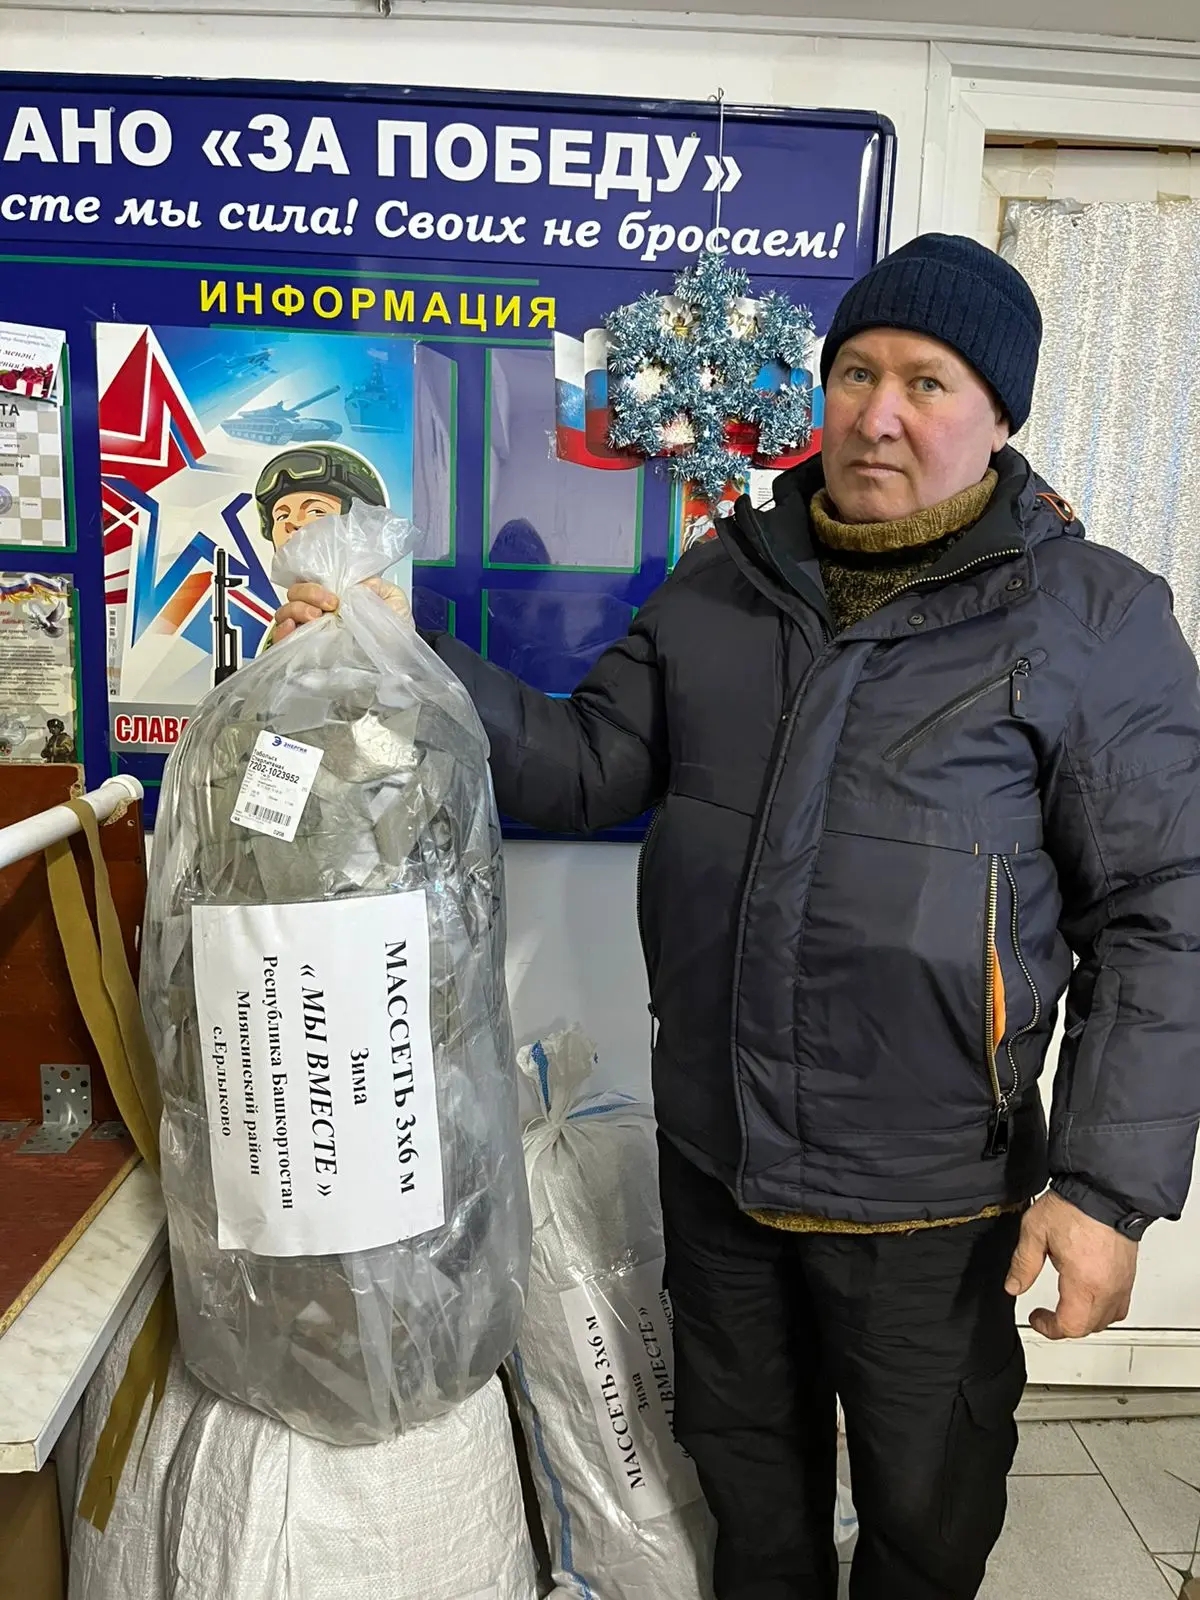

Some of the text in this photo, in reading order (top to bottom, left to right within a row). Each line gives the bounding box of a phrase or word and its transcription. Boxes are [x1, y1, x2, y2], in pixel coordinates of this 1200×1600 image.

[4, 106, 743, 203] АНО «ЗА ПОБЕДУ»
[0, 193, 846, 262] сте мы сила! Своих не бросаем!
[200, 280, 557, 332] ИНФОРМАЦИЯ
[248, 760, 300, 784] 7202-1023952
[301, 985, 328, 1043] МЫ
[212, 1025, 232, 1137] с.Ерлыково
[236, 990, 263, 1176] Миякинский район
[262, 955, 294, 1210] Республика Башкортостан
[349, 1047, 370, 1106] Зима
[384, 939, 415, 1108] МАССЕТЬ
[400, 1171, 416, 1194] м
[306, 1050, 338, 1175] ВМЕСТЕ
[585, 1314, 599, 1331] м
[638, 1319, 675, 1409] ВМЕСТЕ
[601, 1373, 646, 1489] МАССЕТЬ
[631, 1372, 650, 1413] Зима
